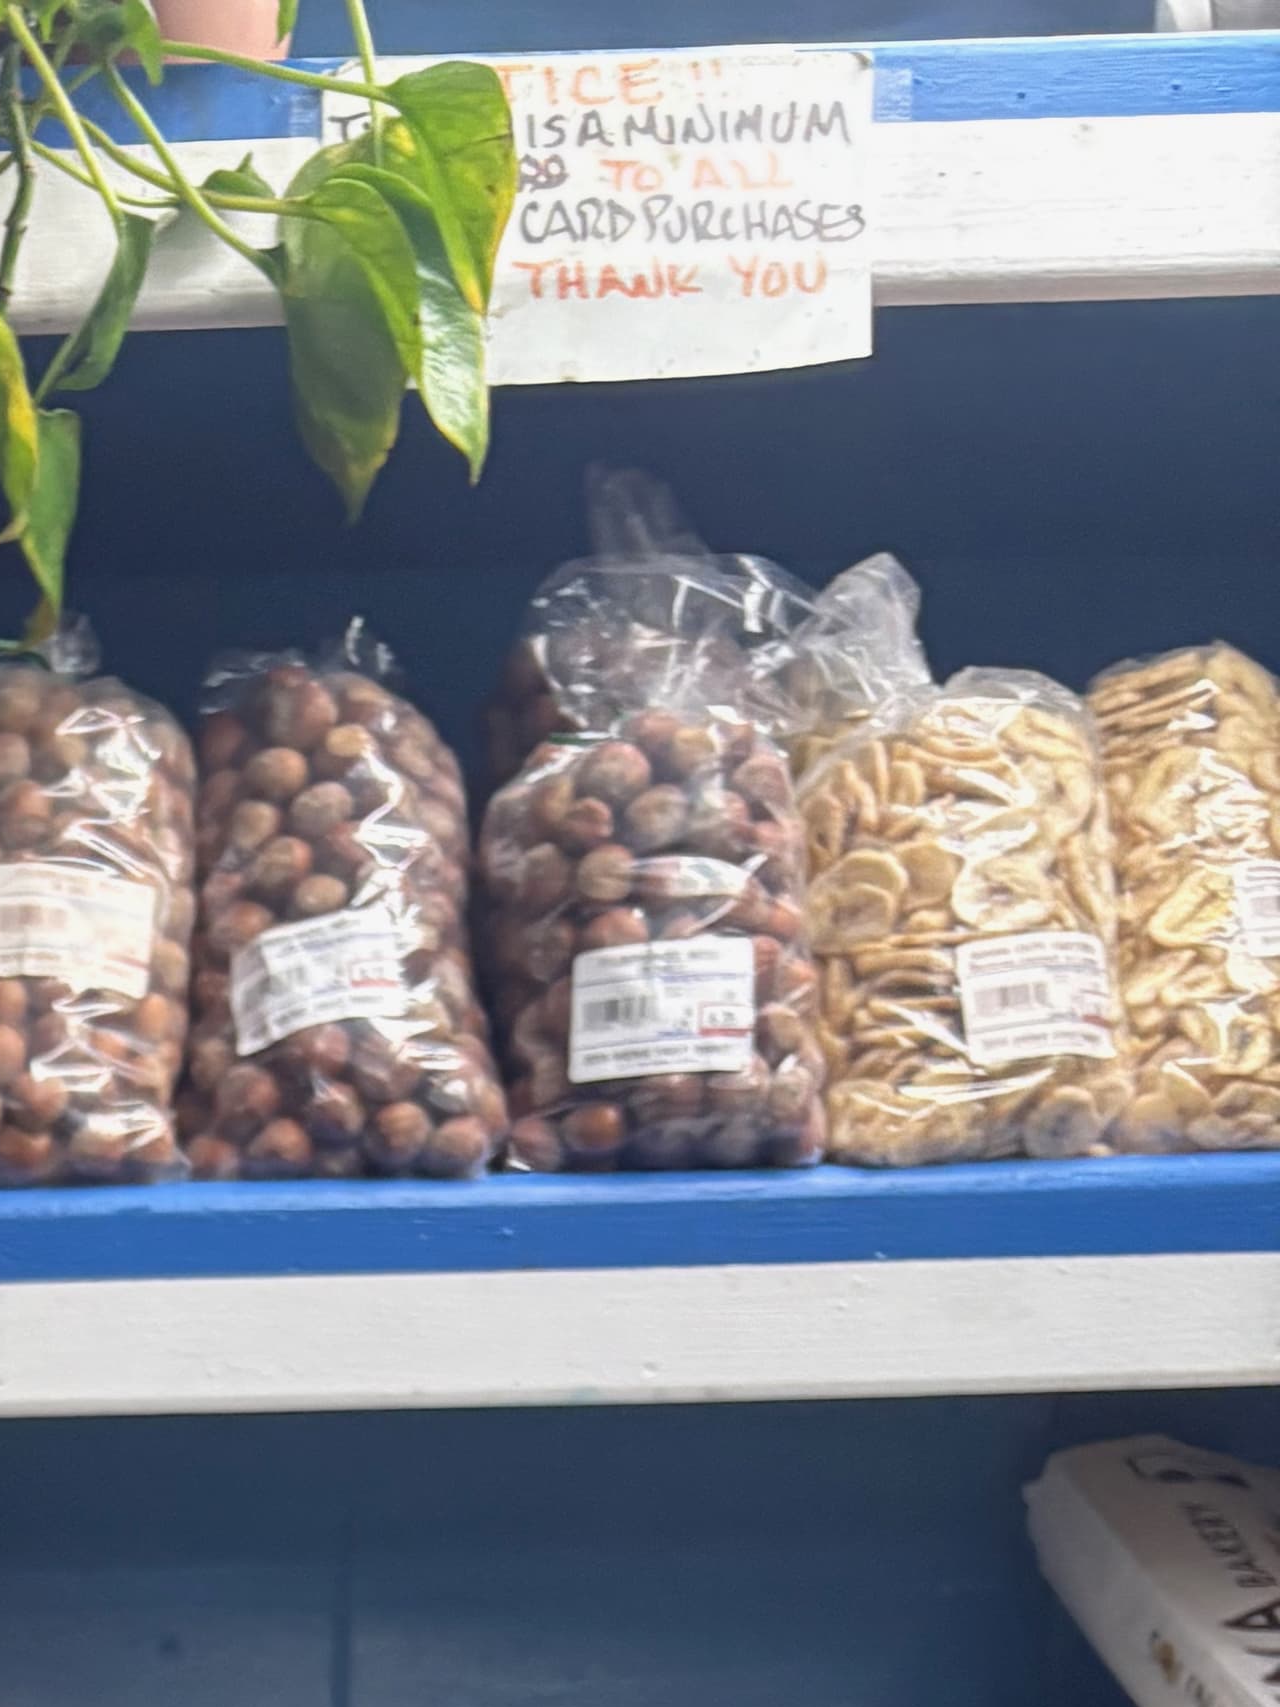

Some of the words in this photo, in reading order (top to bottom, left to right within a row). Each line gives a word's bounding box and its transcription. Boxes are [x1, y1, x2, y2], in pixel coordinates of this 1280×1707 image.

[496, 58, 665, 105] TICE
[526, 114, 567, 149] IS
[598, 158, 666, 194] TO
[691, 152, 794, 191] ALL
[519, 197, 636, 245] CARD
[641, 194, 868, 245] PURCHASES
[512, 256, 704, 300] THANK
[728, 251, 829, 299] YOU
